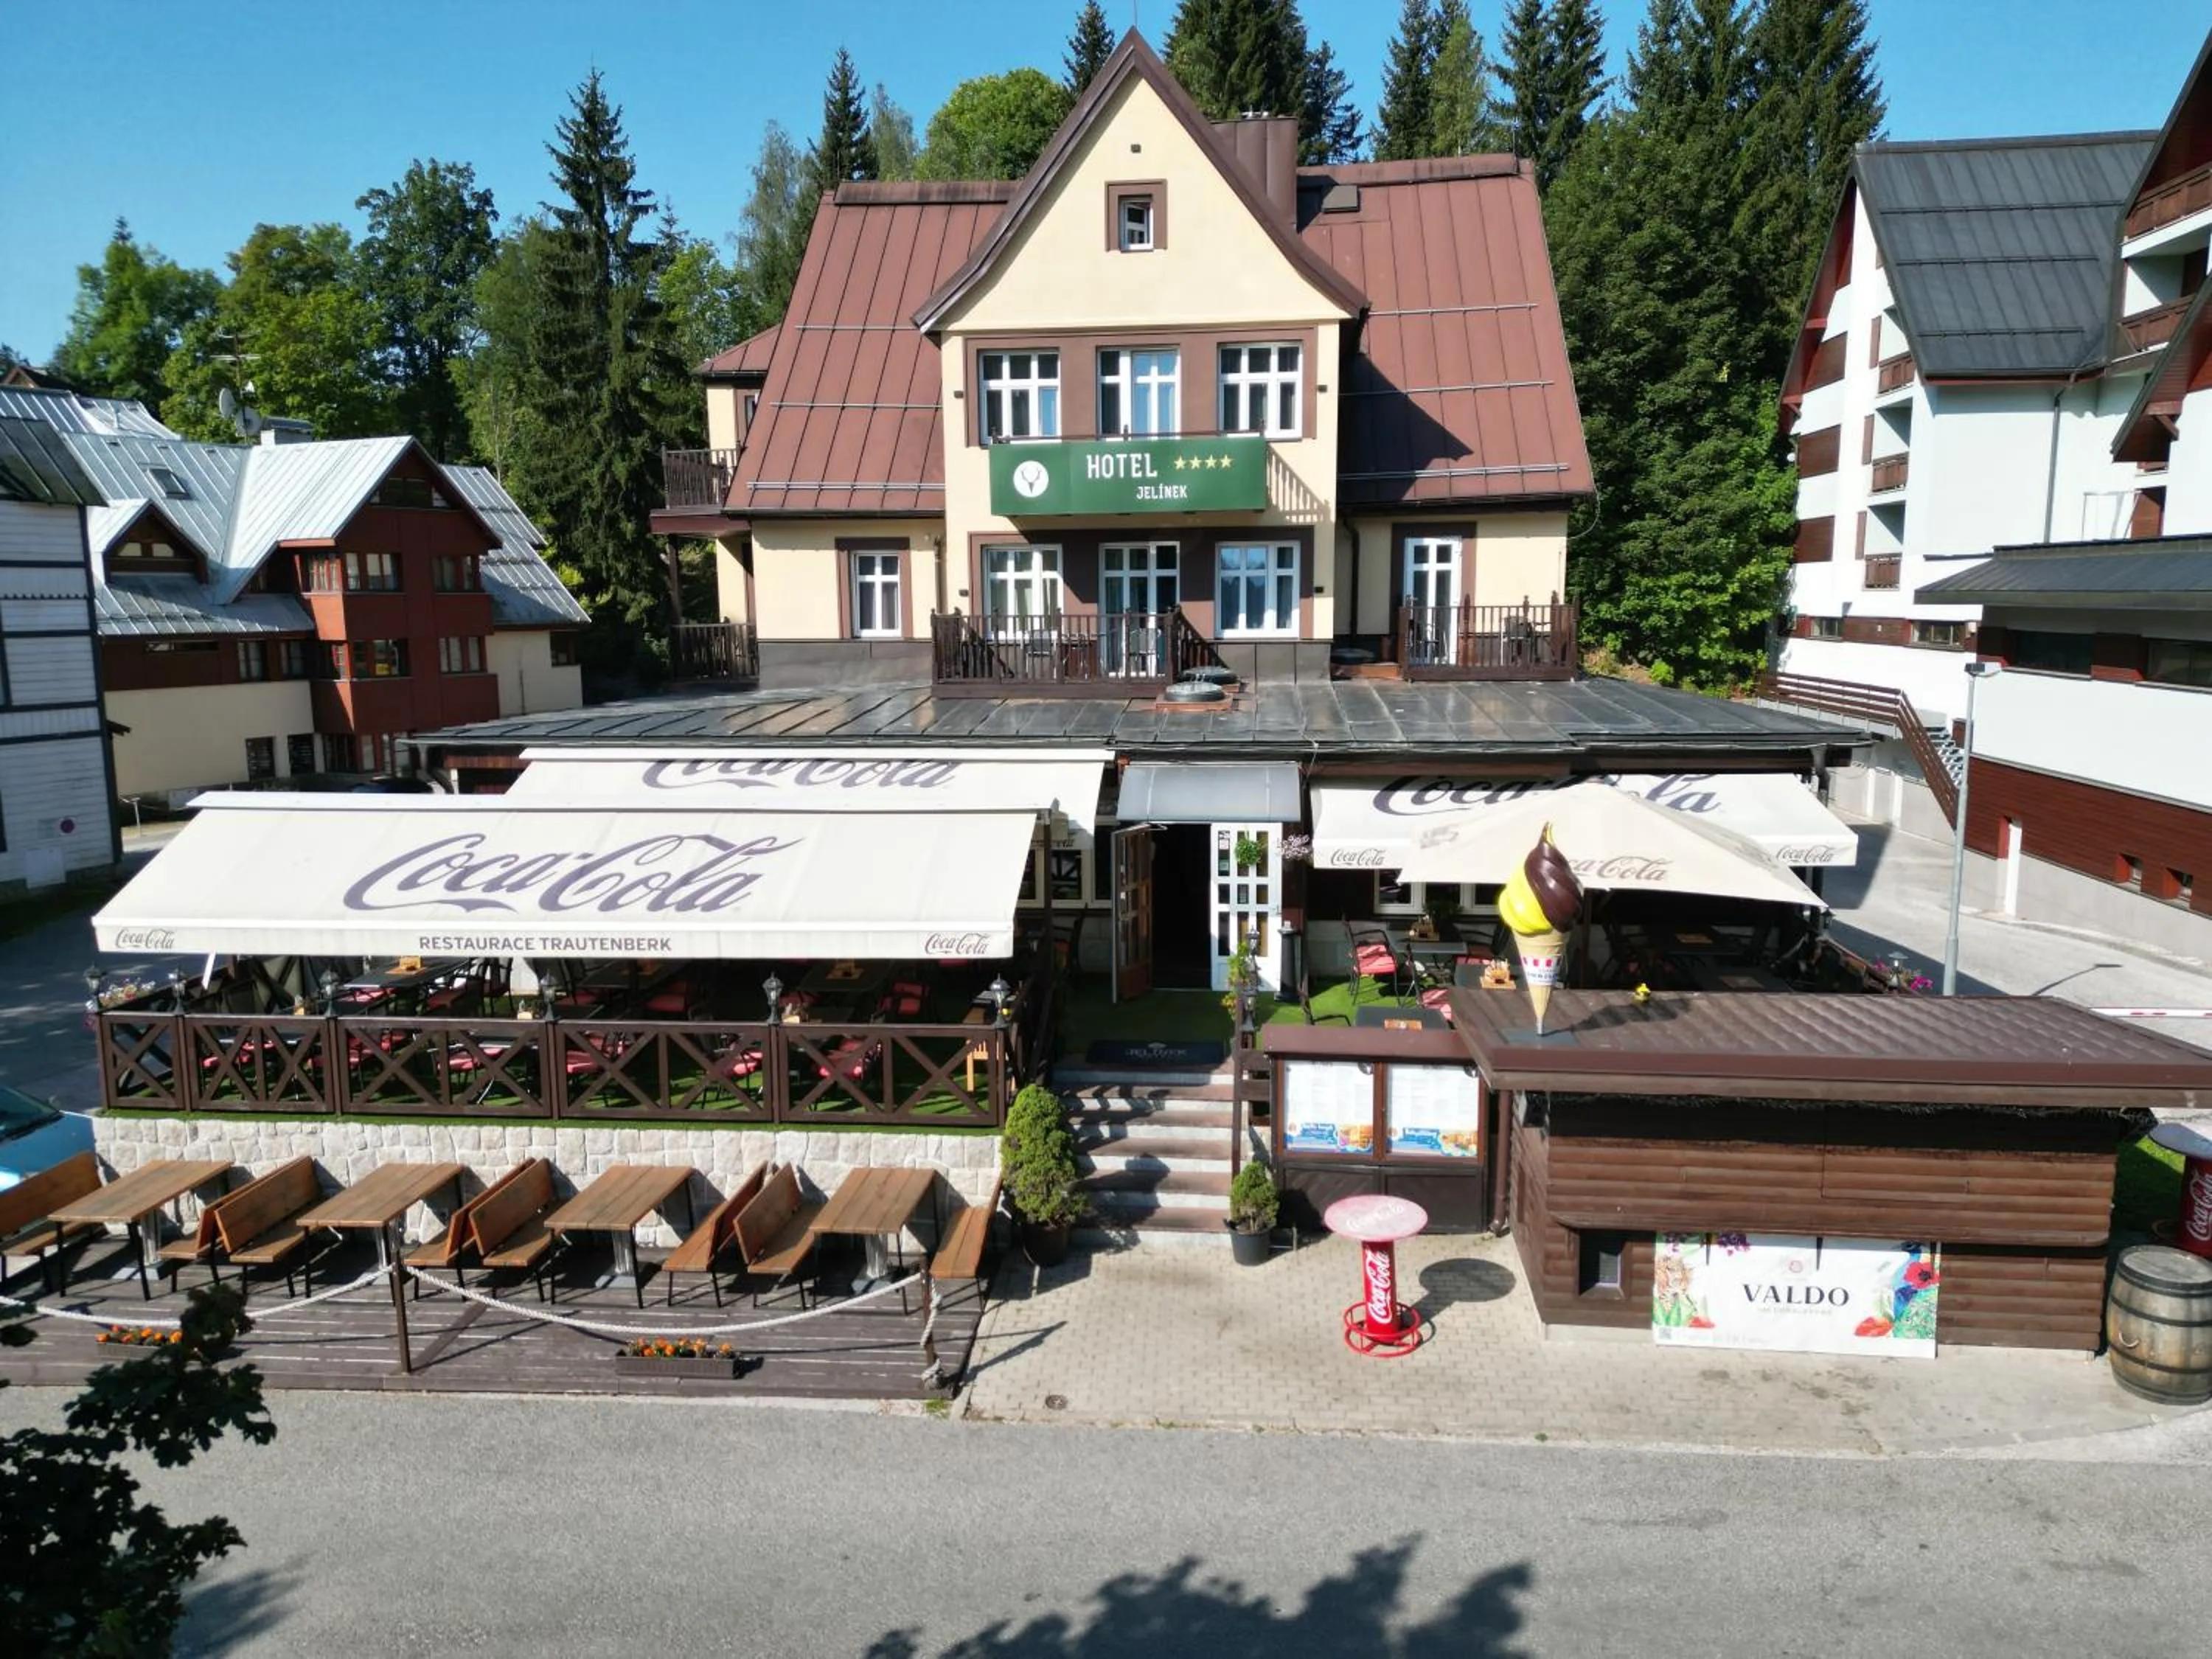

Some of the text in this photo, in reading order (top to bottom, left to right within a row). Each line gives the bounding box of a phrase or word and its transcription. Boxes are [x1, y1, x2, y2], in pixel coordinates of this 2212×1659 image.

[1086, 453, 1158, 479] HOTEL
[1136, 483, 1188, 500] JELÍNEK
[641, 759, 961, 788] CocaCola
[343, 832, 805, 912] Coca-Cola
[420, 936, 672, 951] RESTAURACE TRAUTENBERK
[1743, 1283, 1849, 1307] VALDO
